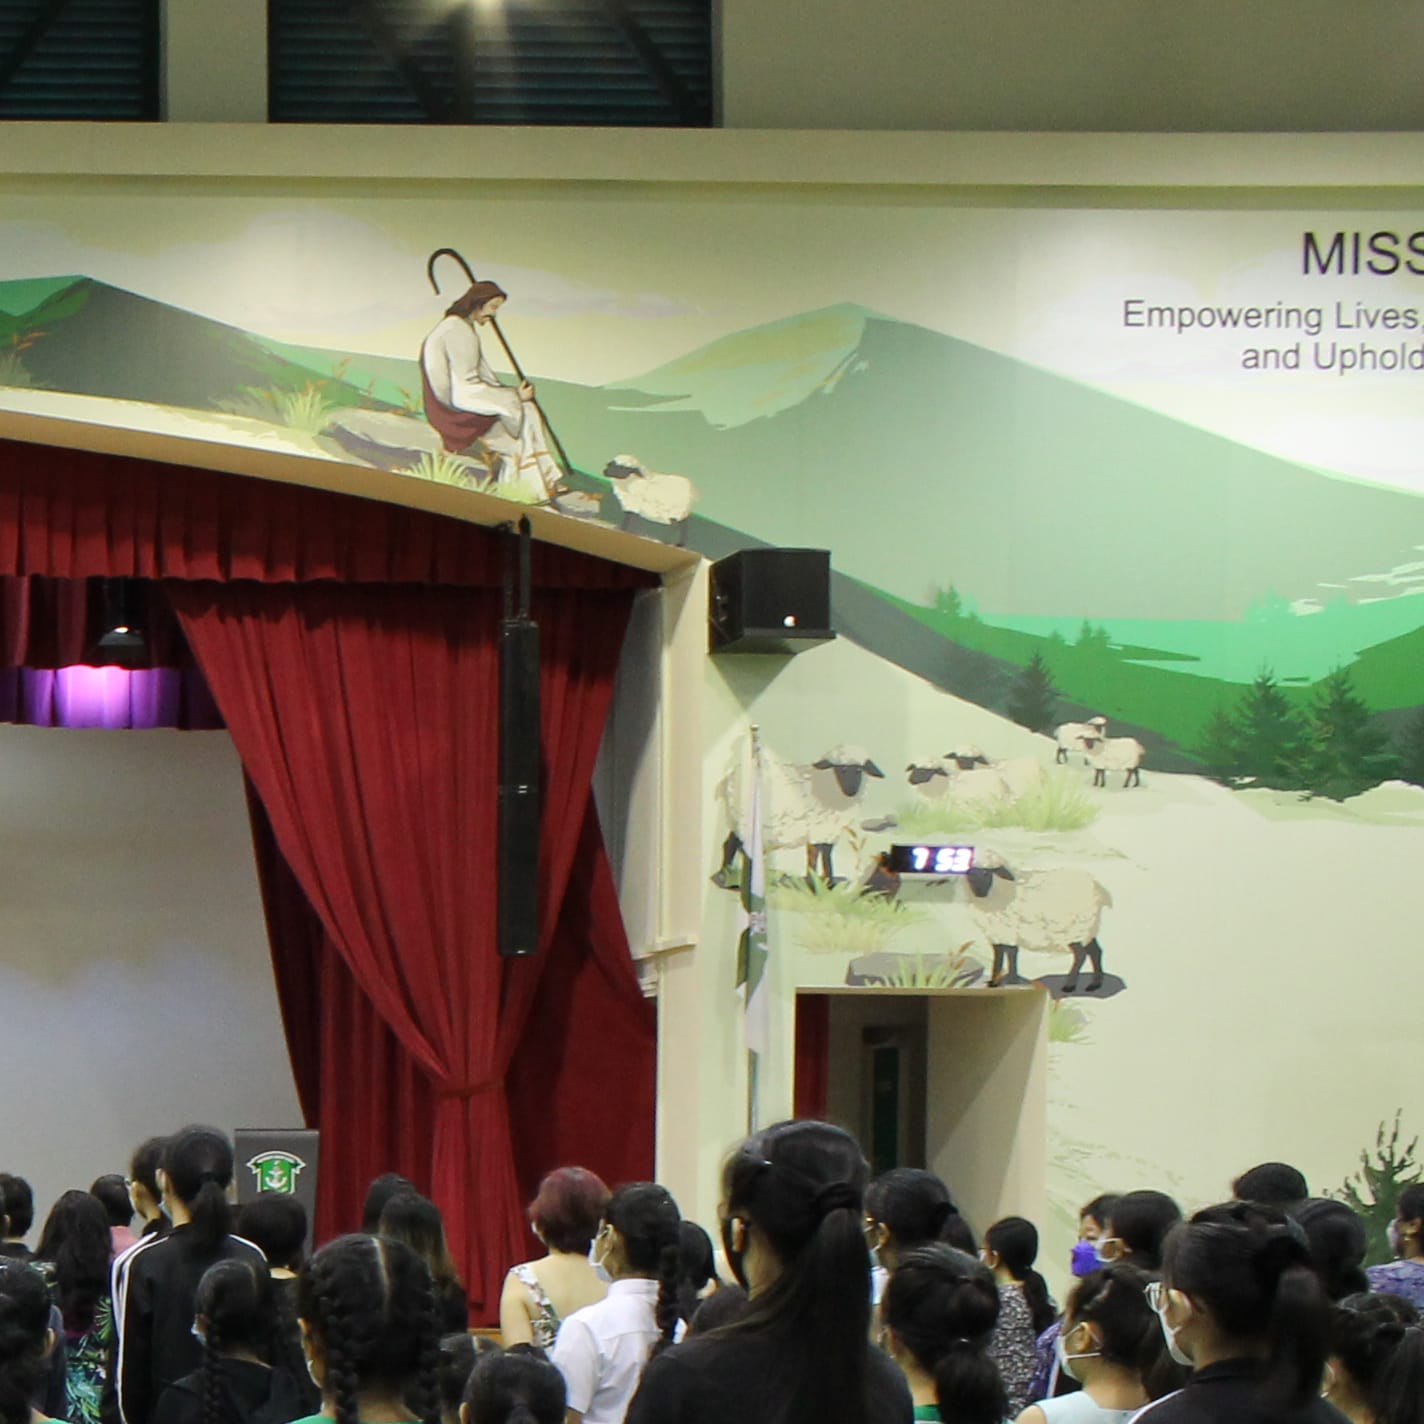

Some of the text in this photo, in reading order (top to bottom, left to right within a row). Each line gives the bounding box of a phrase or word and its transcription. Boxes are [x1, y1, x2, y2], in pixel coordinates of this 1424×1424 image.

[1124, 300, 1322, 336] Empowering
[1242, 343, 1424, 376] and Uphold
